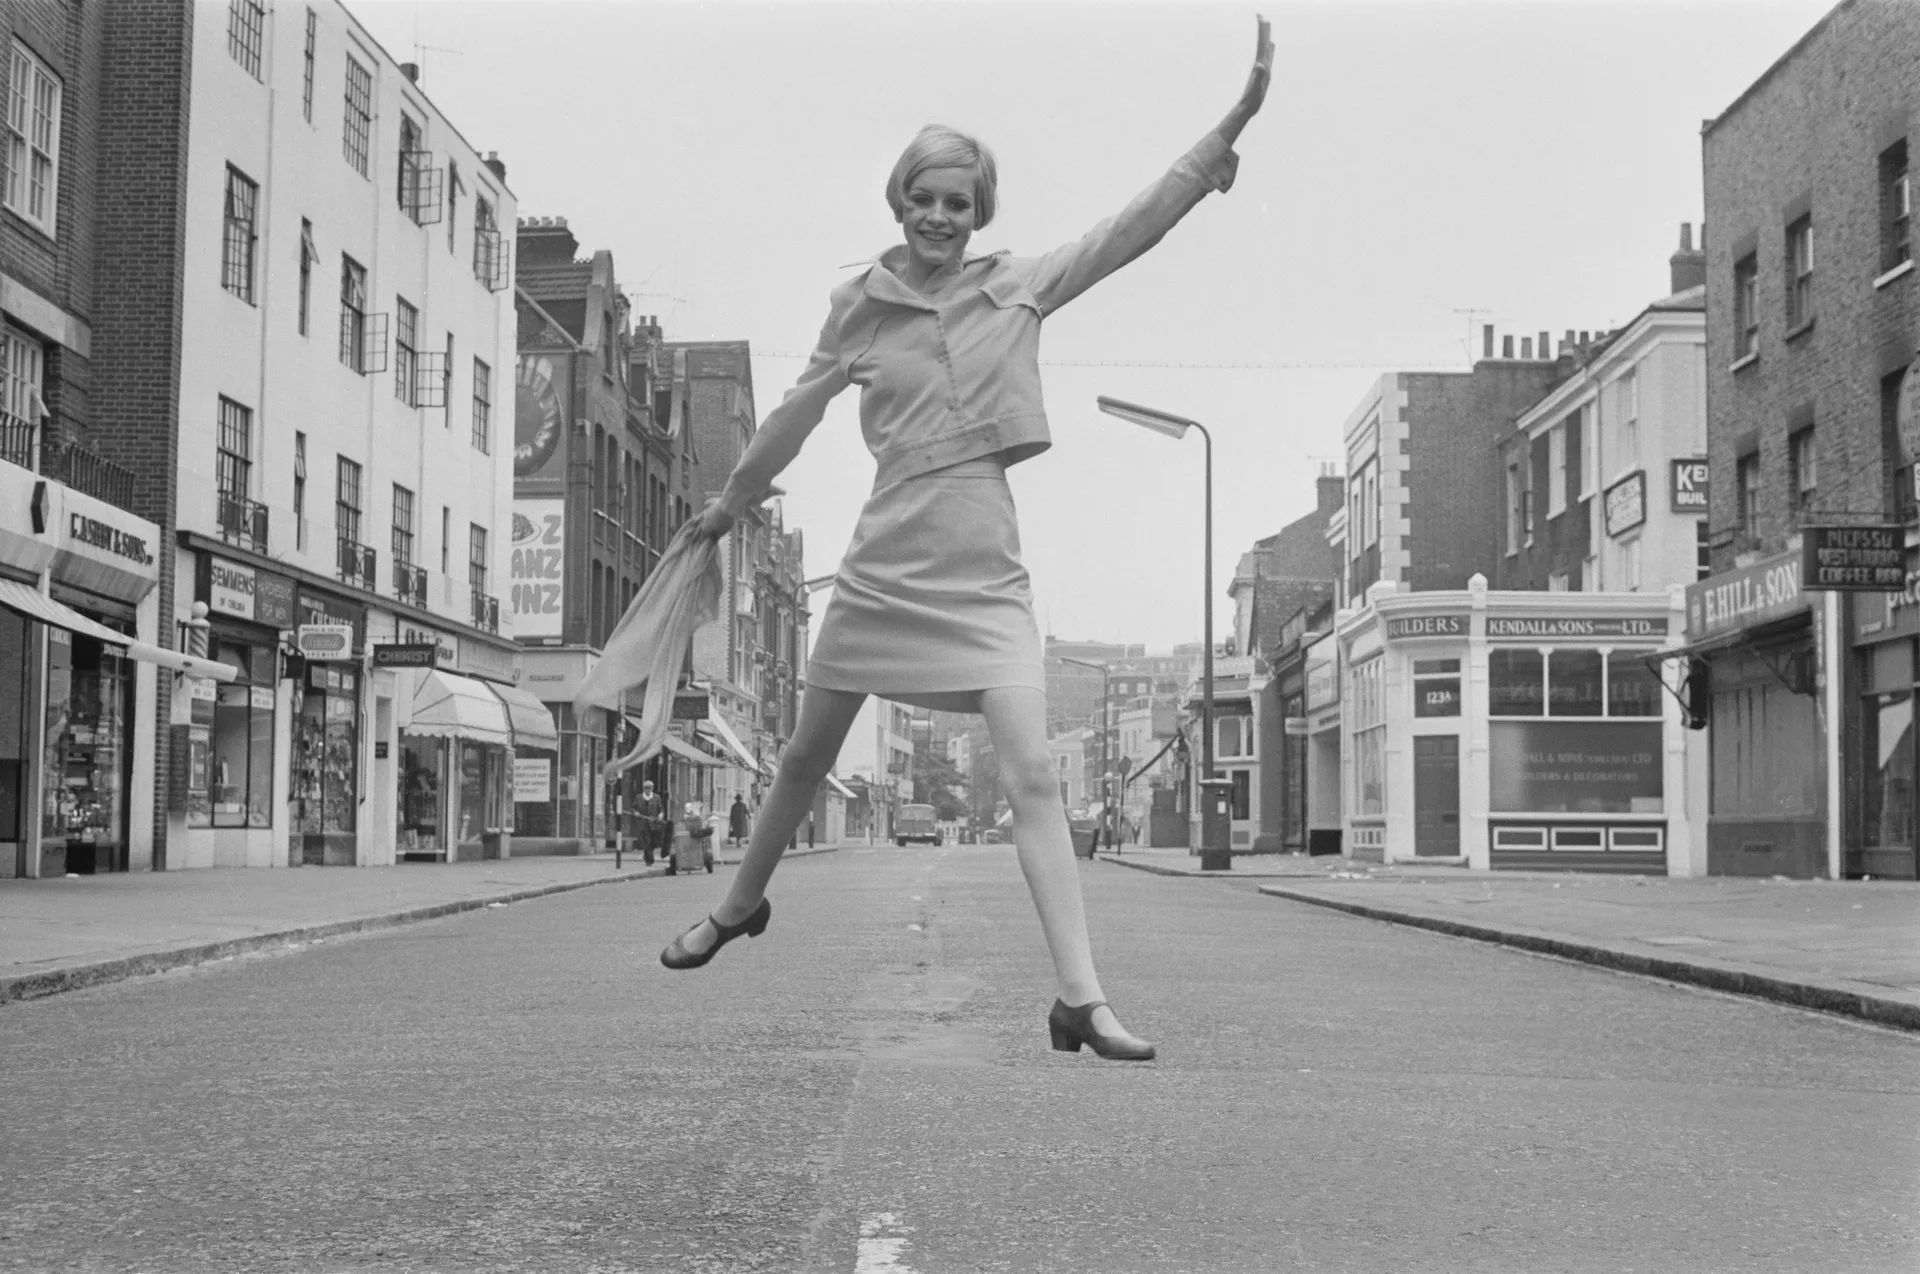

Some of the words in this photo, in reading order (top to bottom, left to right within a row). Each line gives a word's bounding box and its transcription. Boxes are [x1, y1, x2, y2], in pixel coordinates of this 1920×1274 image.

[1677, 464, 1708, 491] KE
[211, 566, 255, 596] SEMMENS
[1766, 562, 1798, 607] SON
[1388, 617, 1459, 635] BUILDERS
[1489, 620, 1546, 634] KENDALL
[1557, 620, 1594, 635] SONS
[1622, 620, 1650, 635] LTD
[378, 650, 431, 663] CHEMIST
[1426, 691, 1452, 704] 123A
